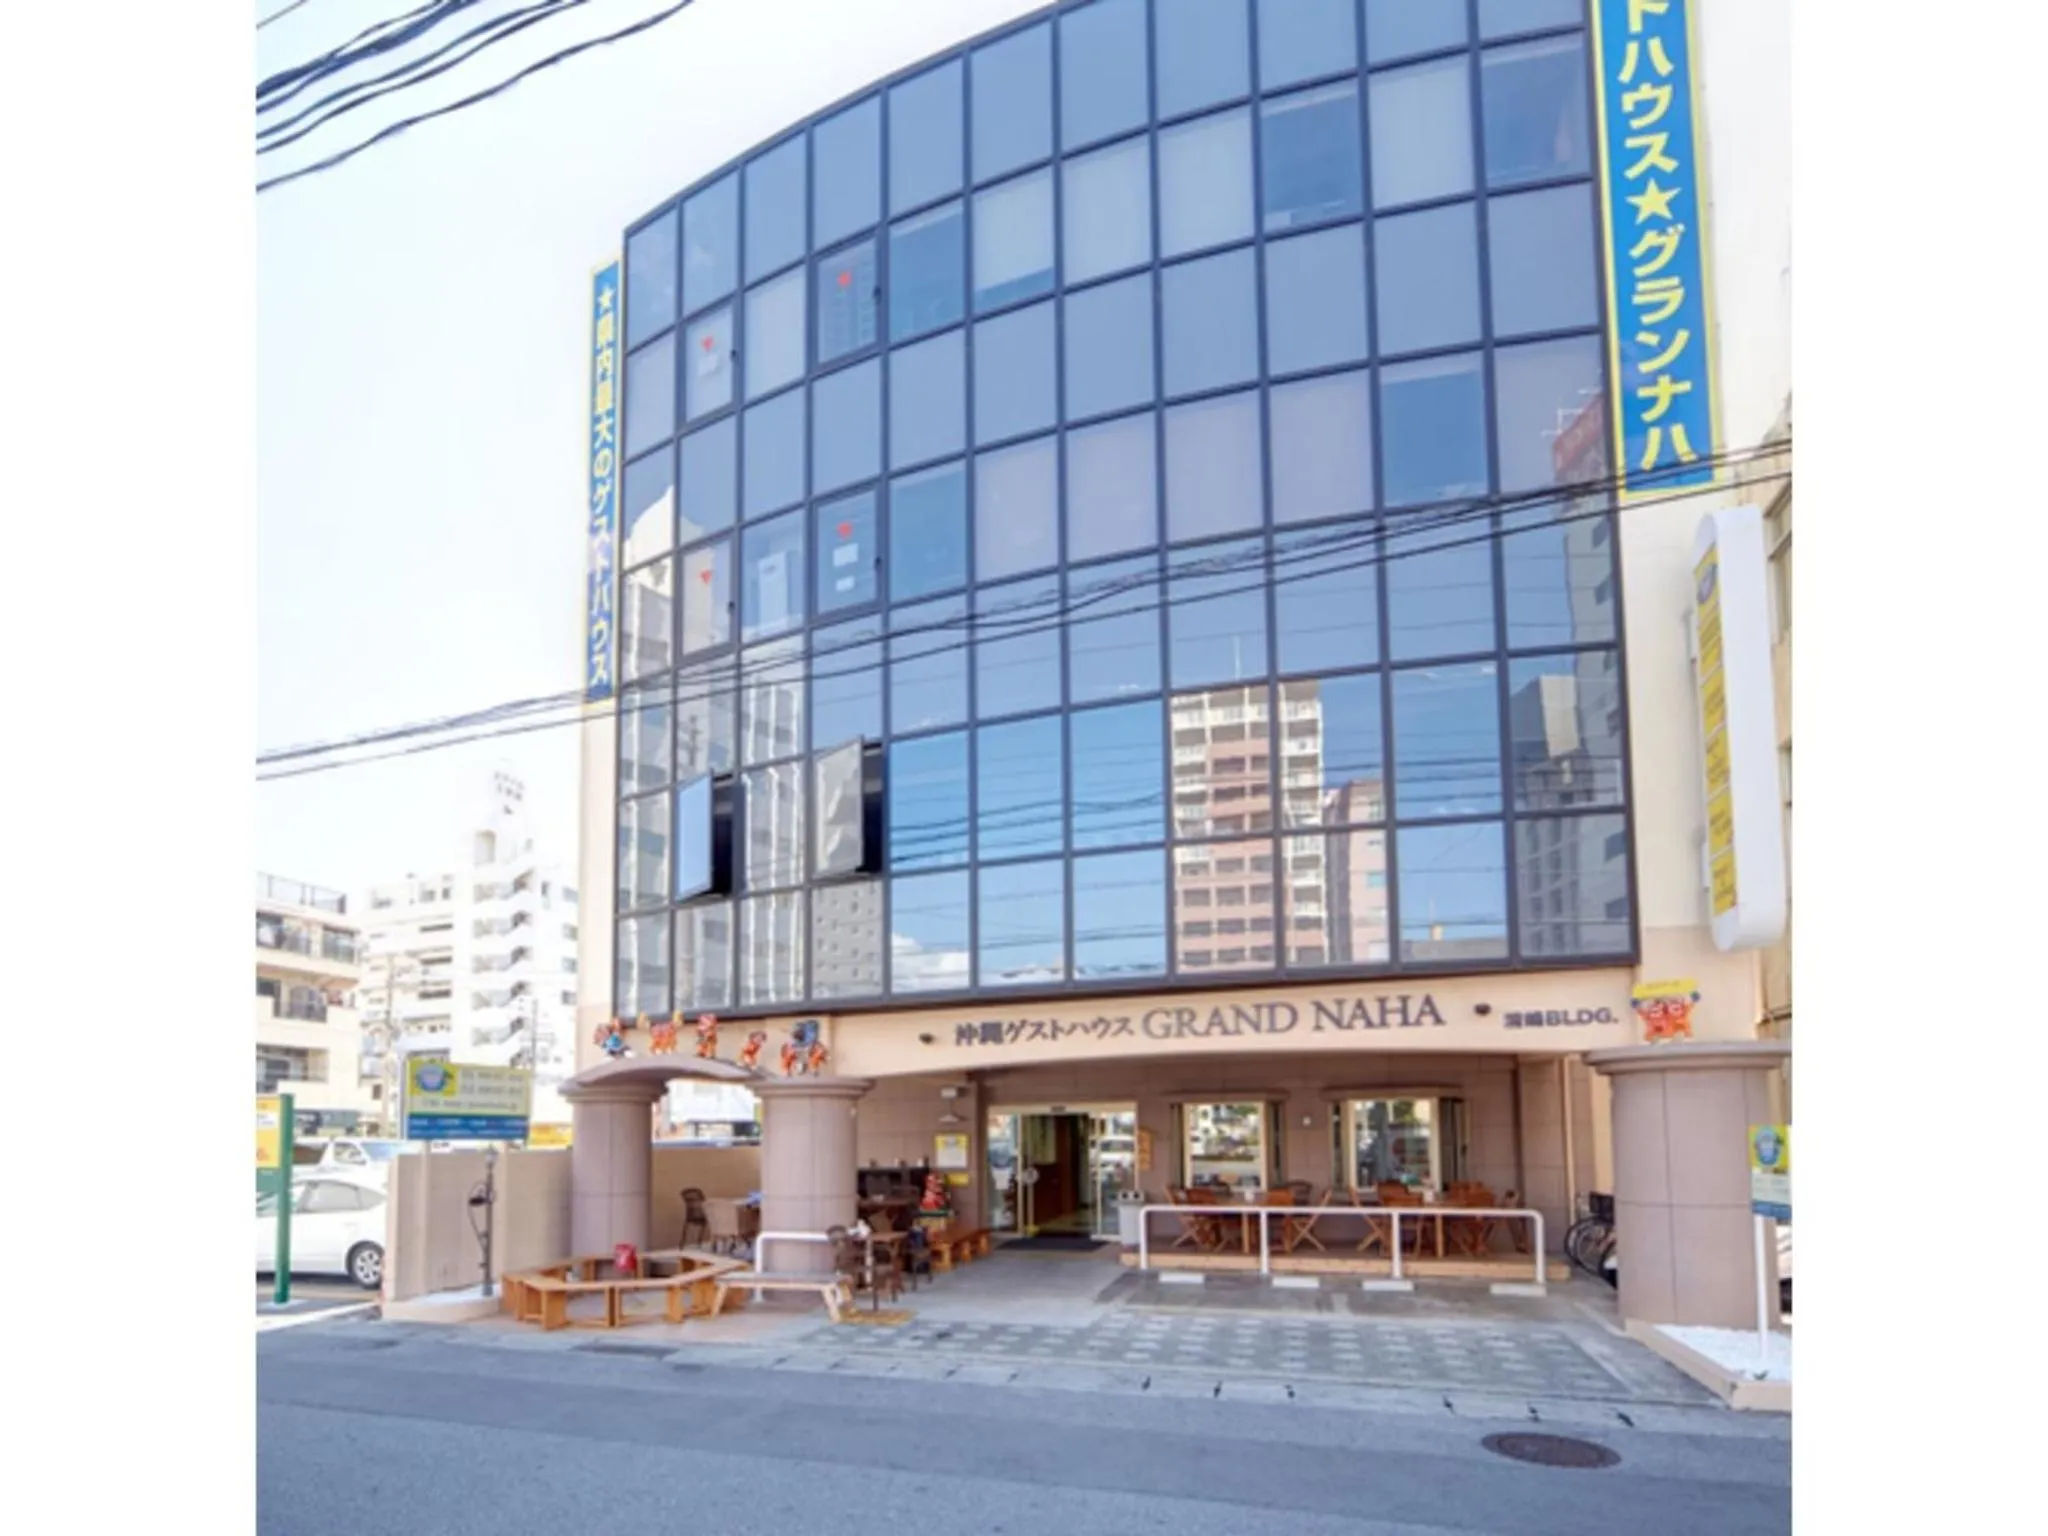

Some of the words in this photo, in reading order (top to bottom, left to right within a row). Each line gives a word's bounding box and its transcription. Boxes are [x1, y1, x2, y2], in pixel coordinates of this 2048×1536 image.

[1142, 1001, 1299, 1040] GRAND
[1311, 993, 1447, 1032] NAHA
[1504, 1007, 1620, 1029] BLDG.
